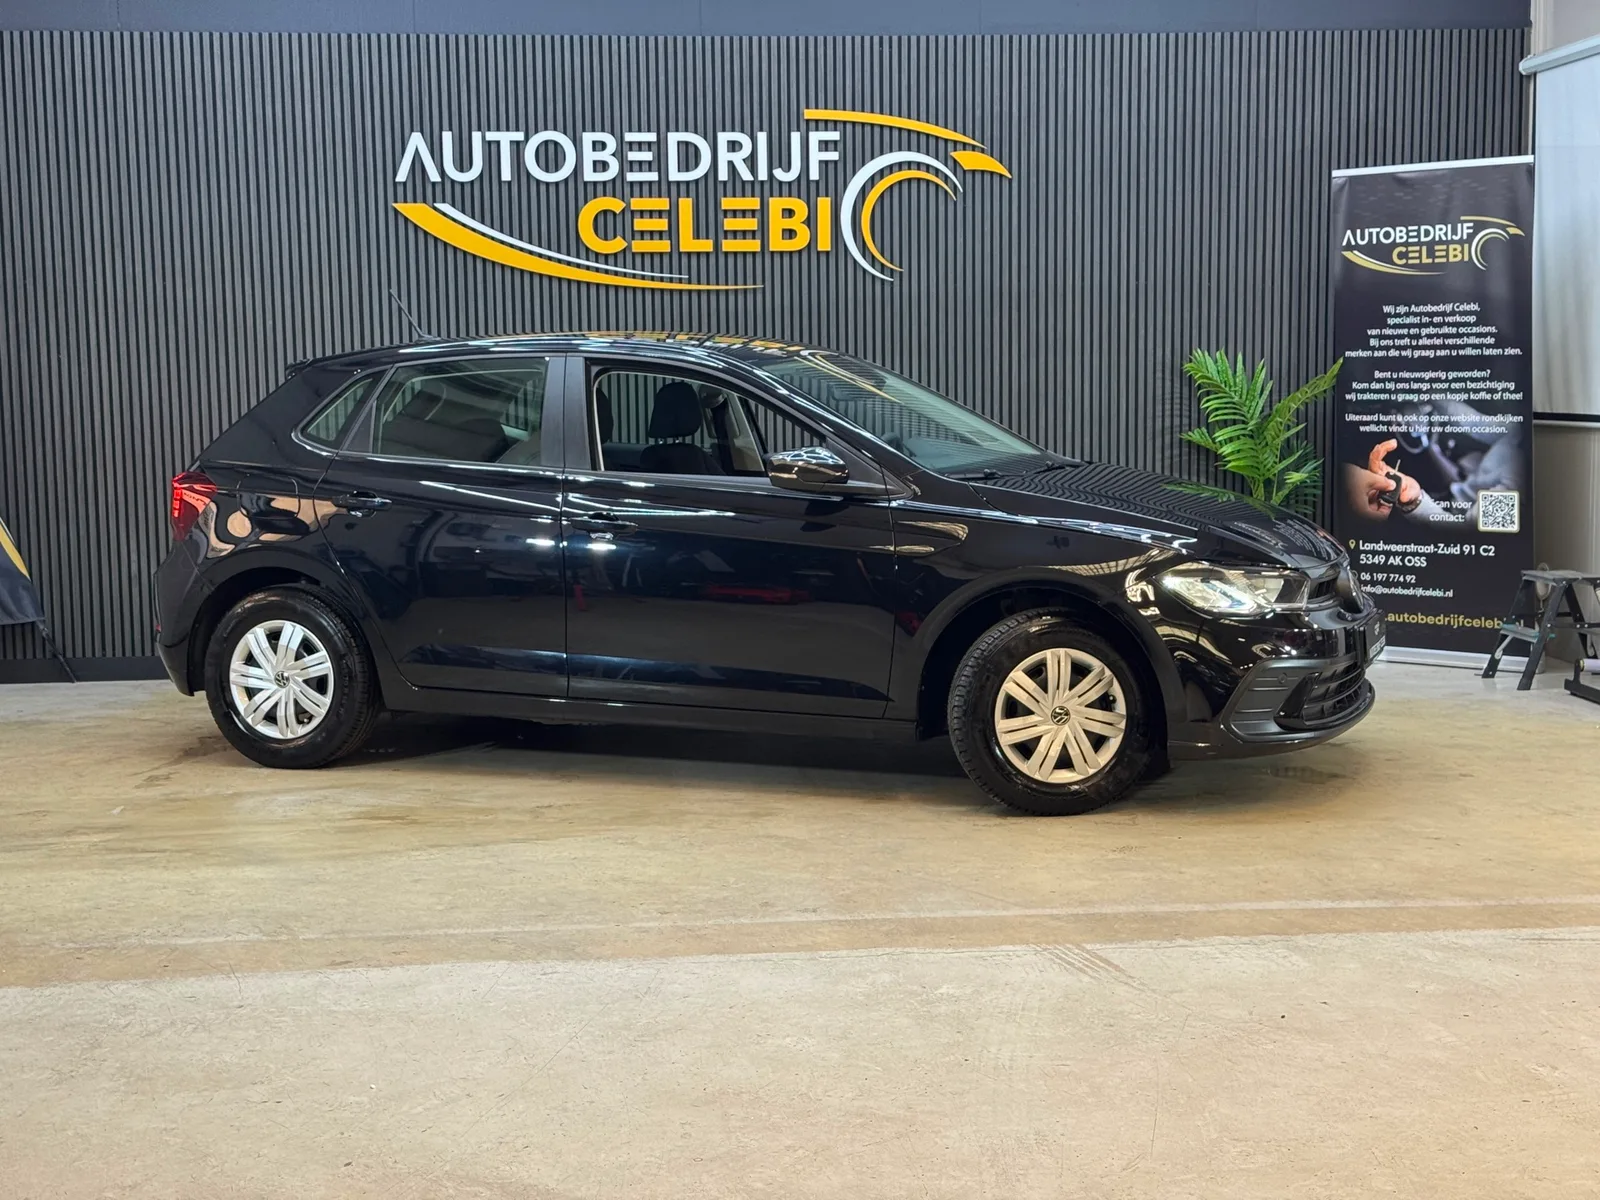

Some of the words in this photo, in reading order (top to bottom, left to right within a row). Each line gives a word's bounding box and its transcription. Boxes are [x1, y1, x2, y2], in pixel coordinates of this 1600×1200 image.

[395, 129, 840, 183] AUTOBEDRIJF
[577, 195, 832, 254] CELEBI
[1342, 223, 1474, 246] AUTOBEDRIJF
[1392, 243, 1469, 265] CELEBI
[1382, 305, 1395, 314] Wij
[1396, 304, 1409, 314] zijn
[1410, 303, 1453, 313] Autobedrijf
[1454, 302, 1481, 312] Celebi,
[1387, 316, 1420, 325] specialist
[1444, 314, 1476, 324] verkoop
[1367, 328, 1381, 336] van
[1381, 327, 1409, 335] nieuwe
[1420, 325, 1458, 336] gebruikte
[1458, 325, 1498, 334] occasions.
[1369, 339, 1380, 348] Bij
[1394, 338, 1411, 346] treft
[1418, 337, 1443, 346] allerlei
[1444, 336, 1495, 345] verschillende
[1345, 349, 1373, 358] merken
[1387, 349, 1400, 357] die
[1401, 349, 1413, 359] wij
[1413, 350, 1435, 359] graag
[1458, 348, 1482, 356] willen
[1483, 347, 1503, 355] laten
[1504, 347, 1523, 355] zien.
[1374, 370, 1391, 379] Bent
[1398, 370, 1446, 380] nieuwsgierig
[1447, 369, 1491, 379] geworden?
[1352, 381, 1369, 390] Kom
[1370, 381, 1384, 390] dan
[1385, 381, 1395, 391] bij
[1410, 381, 1431, 391] langs
[1466, 380, 1515, 390] bezichtiging
[1345, 392, 1356, 402] wij
[1357, 392, 1390, 400] trakteren
[1397, 393, 1419, 402] graag
[1419, 393, 1430, 401] op
[1447, 391, 1468, 402] kopje
[1470, 391, 1492, 400] koffie
[1492, 391, 1502, 400] of
[1345, 413, 1378, 422] Uiteraard
[1379, 413, 1396, 422] kunt
[1403, 413, 1418, 422] ook
[1418, 415, 1429, 423] op
[1450, 414, 1480, 422] website
[1481, 414, 1523, 424] rondkijken
[1359, 424, 1387, 432] wellicht
[1388, 425, 1408, 433] vindt
[1414, 425, 1430, 433] hier
[1444, 425, 1471, 433] droom
[1472, 425, 1508, 433] occasion.
[1451, 501, 1472, 509] voor
[1429, 513, 1465, 522] contact:
[1359, 539, 1461, 555] Landweerstraat-Zuid
[1463, 544, 1475, 555] 91
[1480, 545, 1495, 556] C2
[1359, 554, 1385, 565] 5349
[1387, 555, 1402, 566] AK
[1405, 556, 1427, 567] OSS
[1360, 572, 1371, 581] 06
[1373, 573, 1388, 581] 197
[1389, 574, 1403, 582] 774
[1405, 575, 1416, 583] 92
[1360, 584, 1453, 598] info@autobedrijfcelebi.nl
